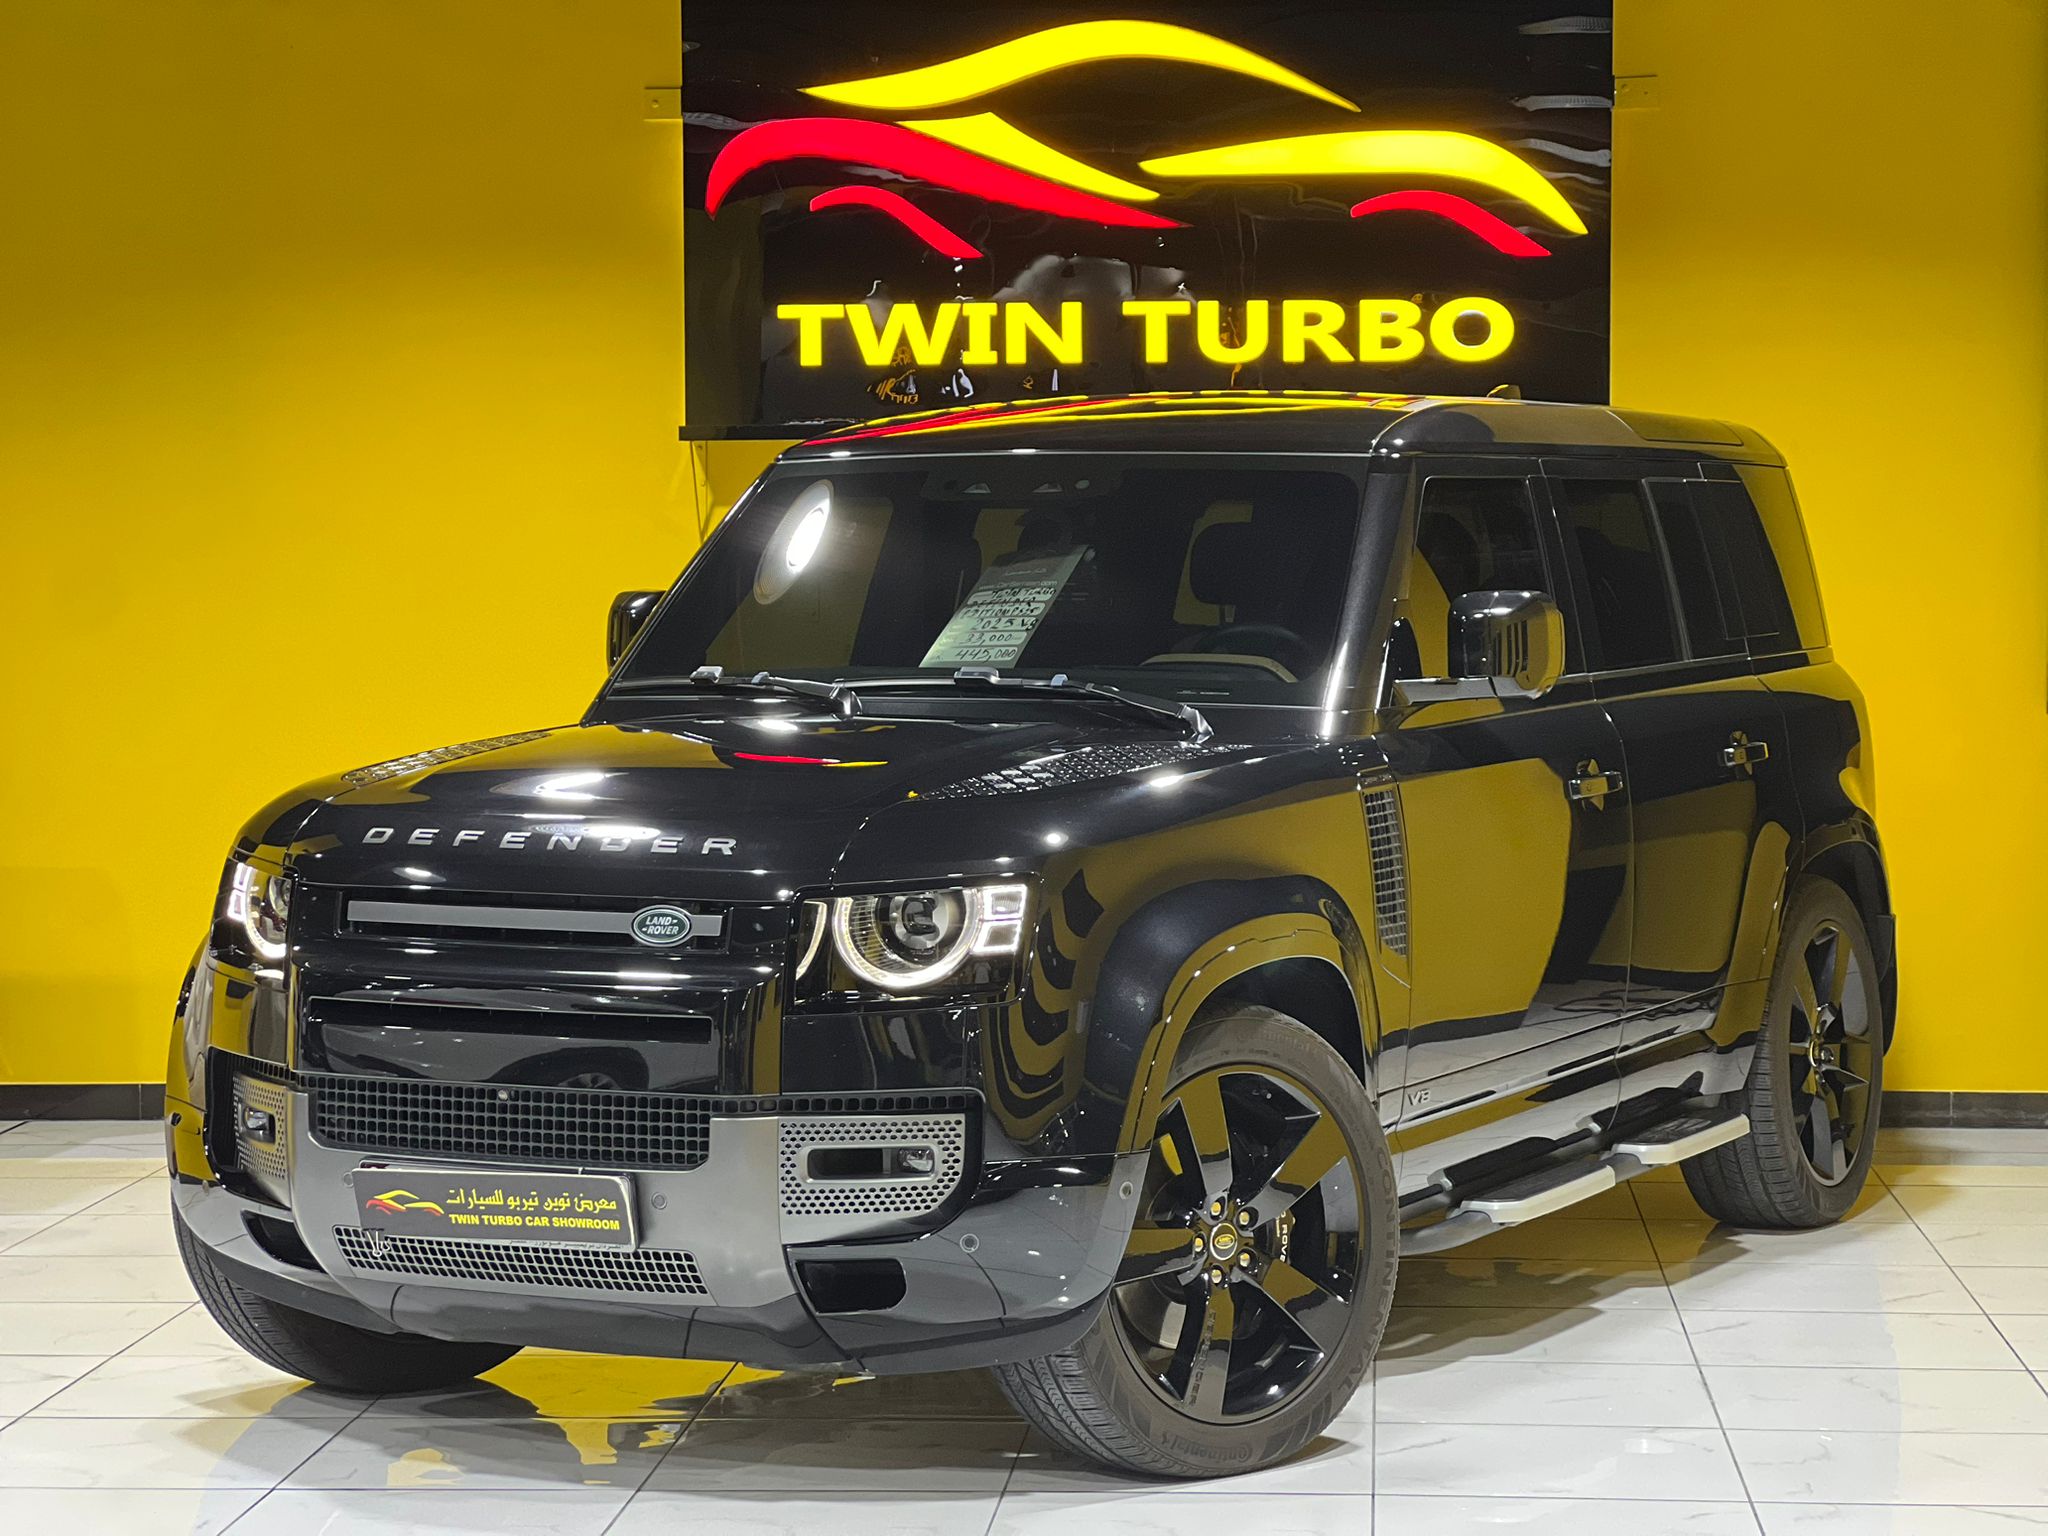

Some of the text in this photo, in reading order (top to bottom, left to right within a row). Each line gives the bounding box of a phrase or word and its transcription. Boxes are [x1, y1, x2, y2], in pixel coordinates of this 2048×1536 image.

[777, 297, 1515, 367] TWIN TURBO
[970, 618, 1015, 630] 2025
[955, 648, 1017, 663] 445,000
[362, 827, 737, 856] DEFENDER
[645, 916, 672, 925] LAND
[646, 926, 679, 935] ROVER
[1406, 1088, 1431, 1106] V8
[446, 1188, 617, 1213] معرض توين تيربو للسيارات
[449, 1214, 620, 1230] TWIN TURBO CAR SHOWROOM
[1280, 1224, 1288, 1262] ROVE
